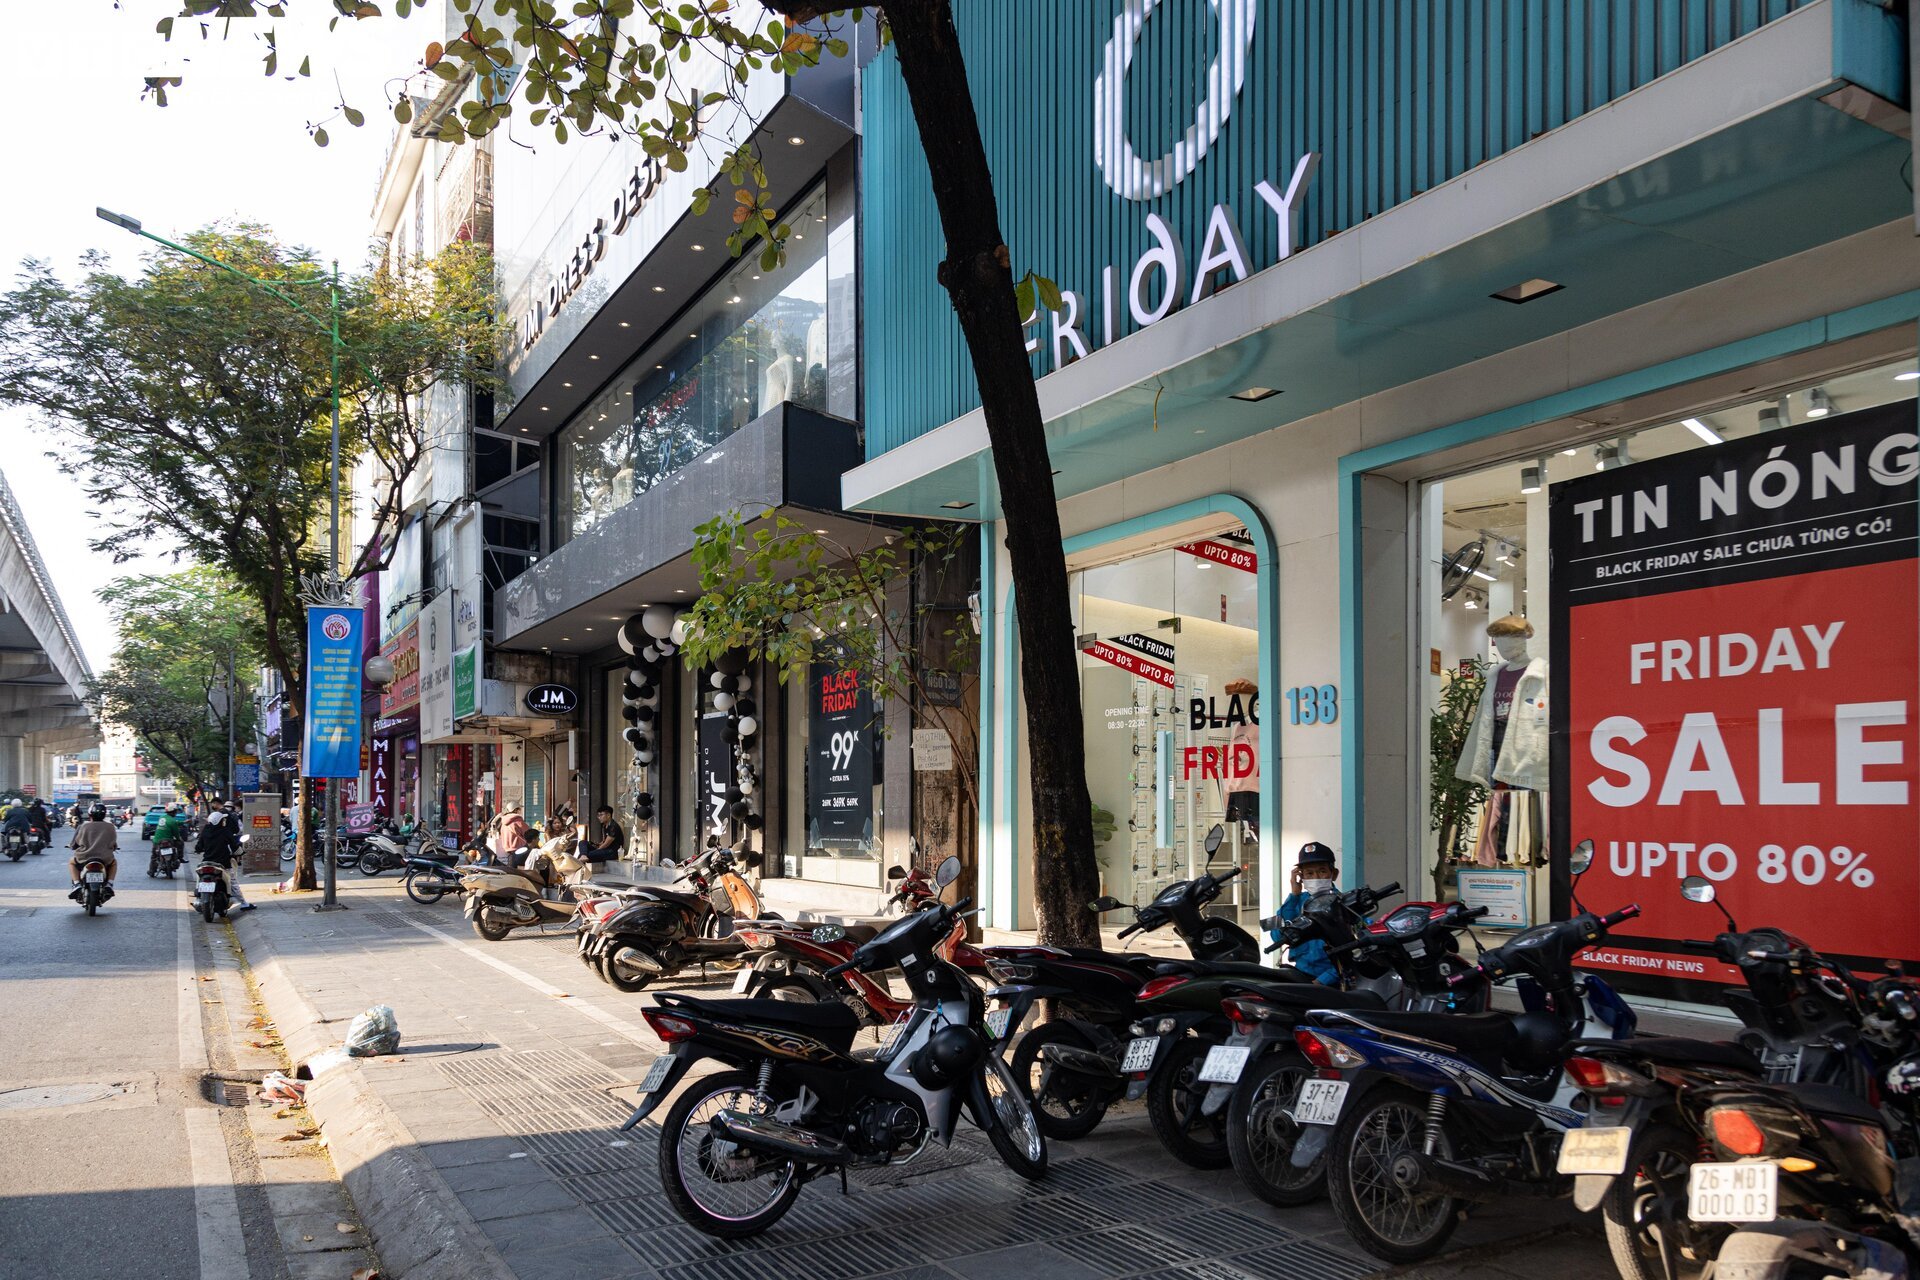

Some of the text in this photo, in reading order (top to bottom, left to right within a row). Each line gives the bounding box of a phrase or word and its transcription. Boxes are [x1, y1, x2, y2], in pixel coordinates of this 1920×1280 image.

[522, 301, 543, 350] JM
[548, 218, 608, 318] DRESS
[1574, 432, 1919, 543] TIN NÓNG
[1204, 544, 1228, 560] UPTO
[1231, 552, 1251, 568] 80%
[1596, 516, 1893, 579] BLACK FRIDAY SALE CHƯA TỪNG CÓ!
[1094, 644, 1114, 660] UPTO
[1116, 653, 1132, 668] 80%
[1139, 663, 1161, 679] UPTO
[1145, 641, 1175, 660] FRIDAY
[1631, 621, 1845, 684] FRIDAY
[822, 669, 859, 695] BLACK
[540, 690, 564, 704] JM
[822, 690, 859, 713] FRIDAY
[1285, 684, 1339, 726] 138
[1104, 705, 1149, 717] OPENING TIME
[1107, 721, 1124, 730] 08:30
[1128, 719, 1145, 728] 22:30
[1184, 743, 1260, 781] FRID
[1587, 700, 1909, 807] SALE
[710, 771, 726, 835] JM
[350, 813, 372, 827] 69
[1609, 841, 1875, 888] UPTO 80%
[1583, 952, 1620, 965] BLACK
[1622, 954, 1664, 969] FRIDAY
[1667, 958, 1704, 973] NEWS
[1123, 1054, 1152, 1069] 361.35
[1698, 1194, 1768, 1216] 000.03
